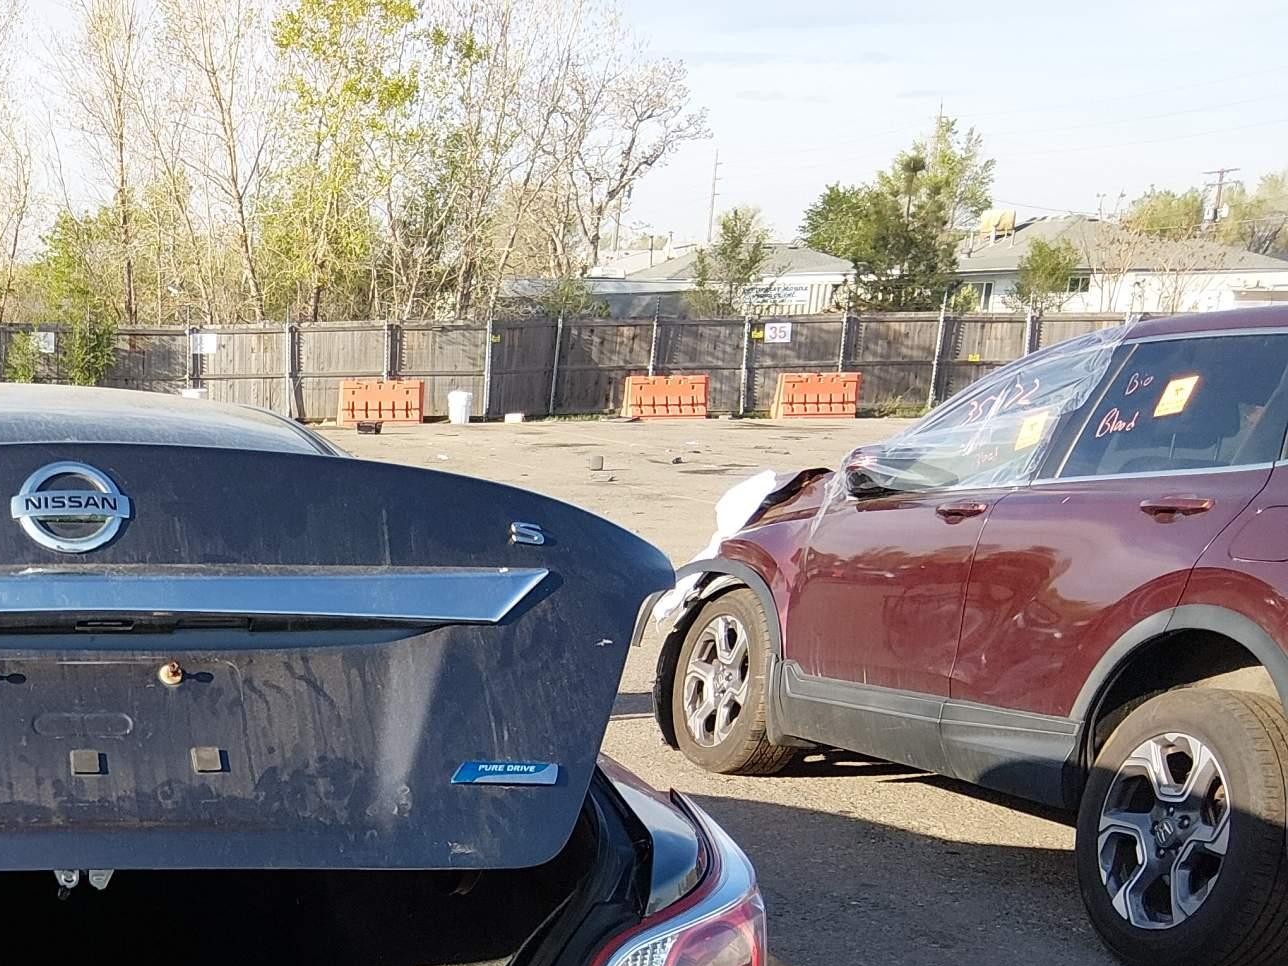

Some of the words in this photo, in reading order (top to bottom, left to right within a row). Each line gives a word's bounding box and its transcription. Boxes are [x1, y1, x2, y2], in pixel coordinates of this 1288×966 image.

[769, 326, 787, 340] 35
[1124, 372, 1154, 396] Bio
[1095, 407, 1140, 438] Blood
[25, 496, 118, 511] NISSAN
[511, 521, 545, 545] S
[478, 764, 505, 772] PURE
[506, 764, 536, 772] DRIVE
